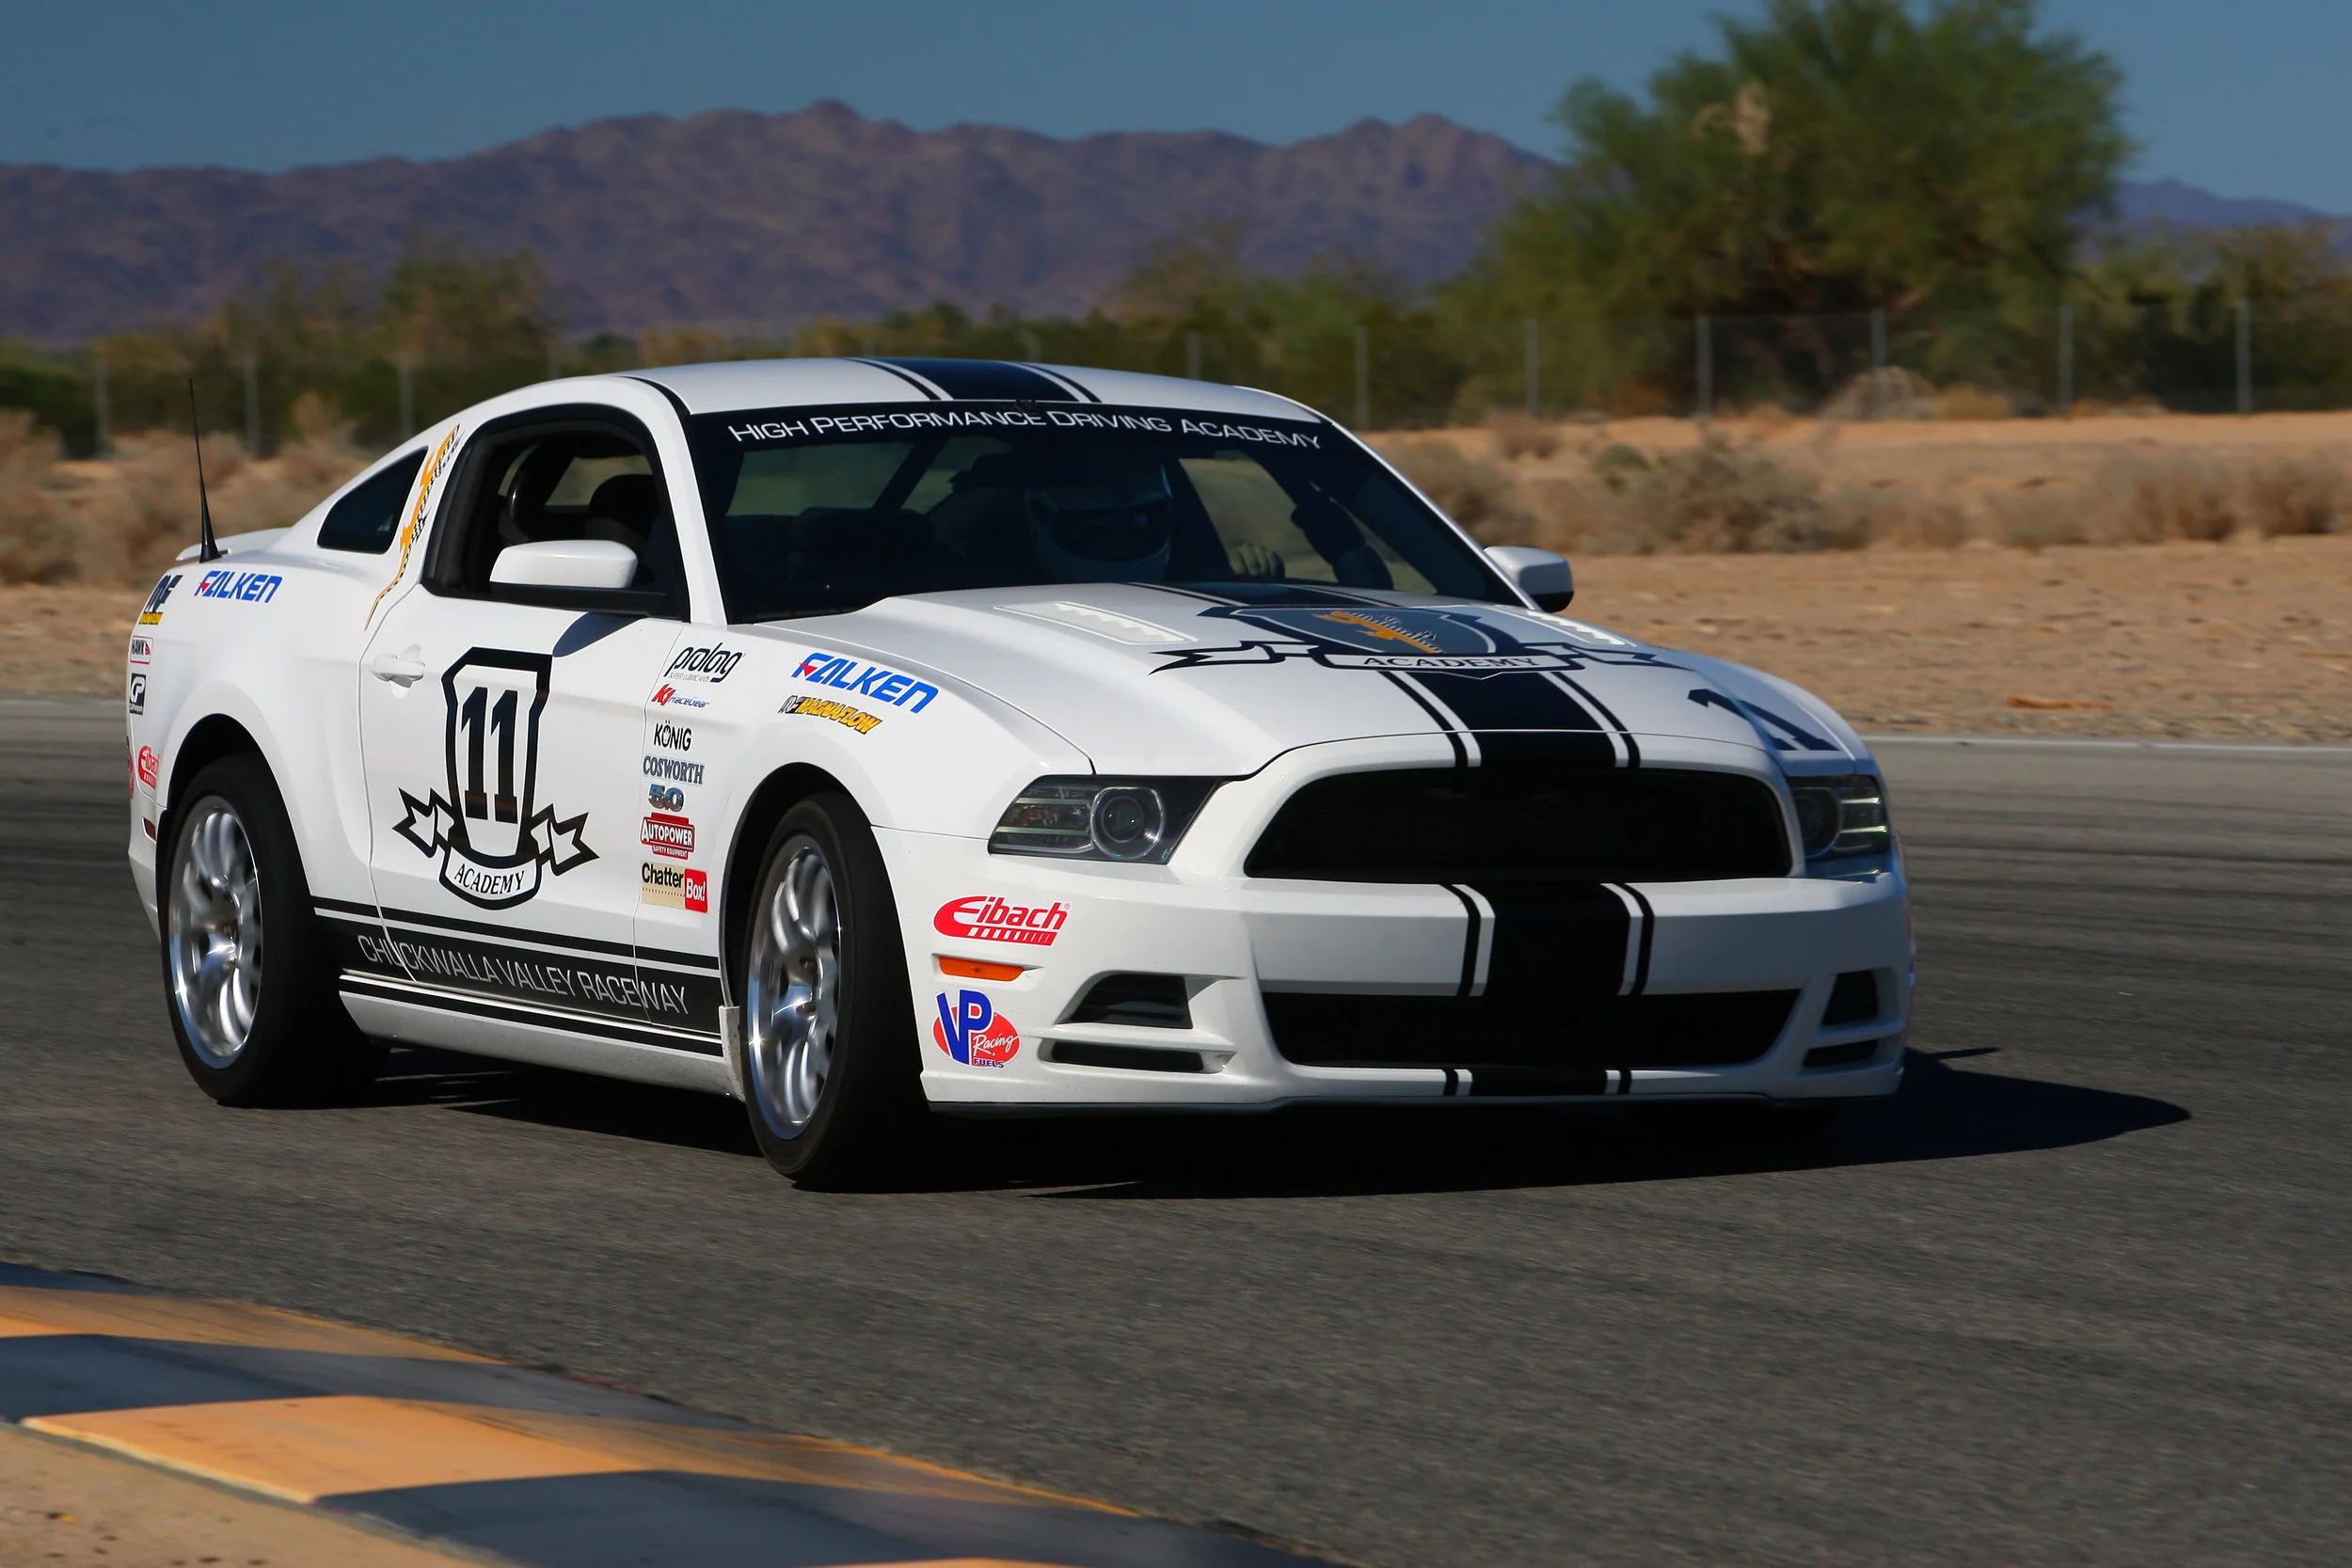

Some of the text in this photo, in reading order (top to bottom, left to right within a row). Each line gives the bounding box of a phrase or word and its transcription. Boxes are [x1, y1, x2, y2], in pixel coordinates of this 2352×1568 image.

[728, 410, 1322, 450] HIGH PERFORMANCE DRIVING ACADEMY
[194, 570, 282, 603] FALKEN
[1363, 657, 1540, 668] ACADEMY
[791, 652, 939, 714] FALKEN
[795, 696, 882, 735] MAGNAFLOW
[653, 720, 692, 751] KÖNIG
[460, 687, 518, 825] 11
[643, 755, 704, 784] COSWORTH
[454, 863, 525, 894] ACADEMY
[642, 863, 684, 888] Chatter
[933, 896, 1068, 945] Eibach
[358, 935, 690, 1016] CHUCKWALLA VALLEY RACEWAY
[935, 989, 993, 1065] VP
[972, 1032, 1020, 1056] Racing
[973, 1058, 1005, 1069] FUELS
